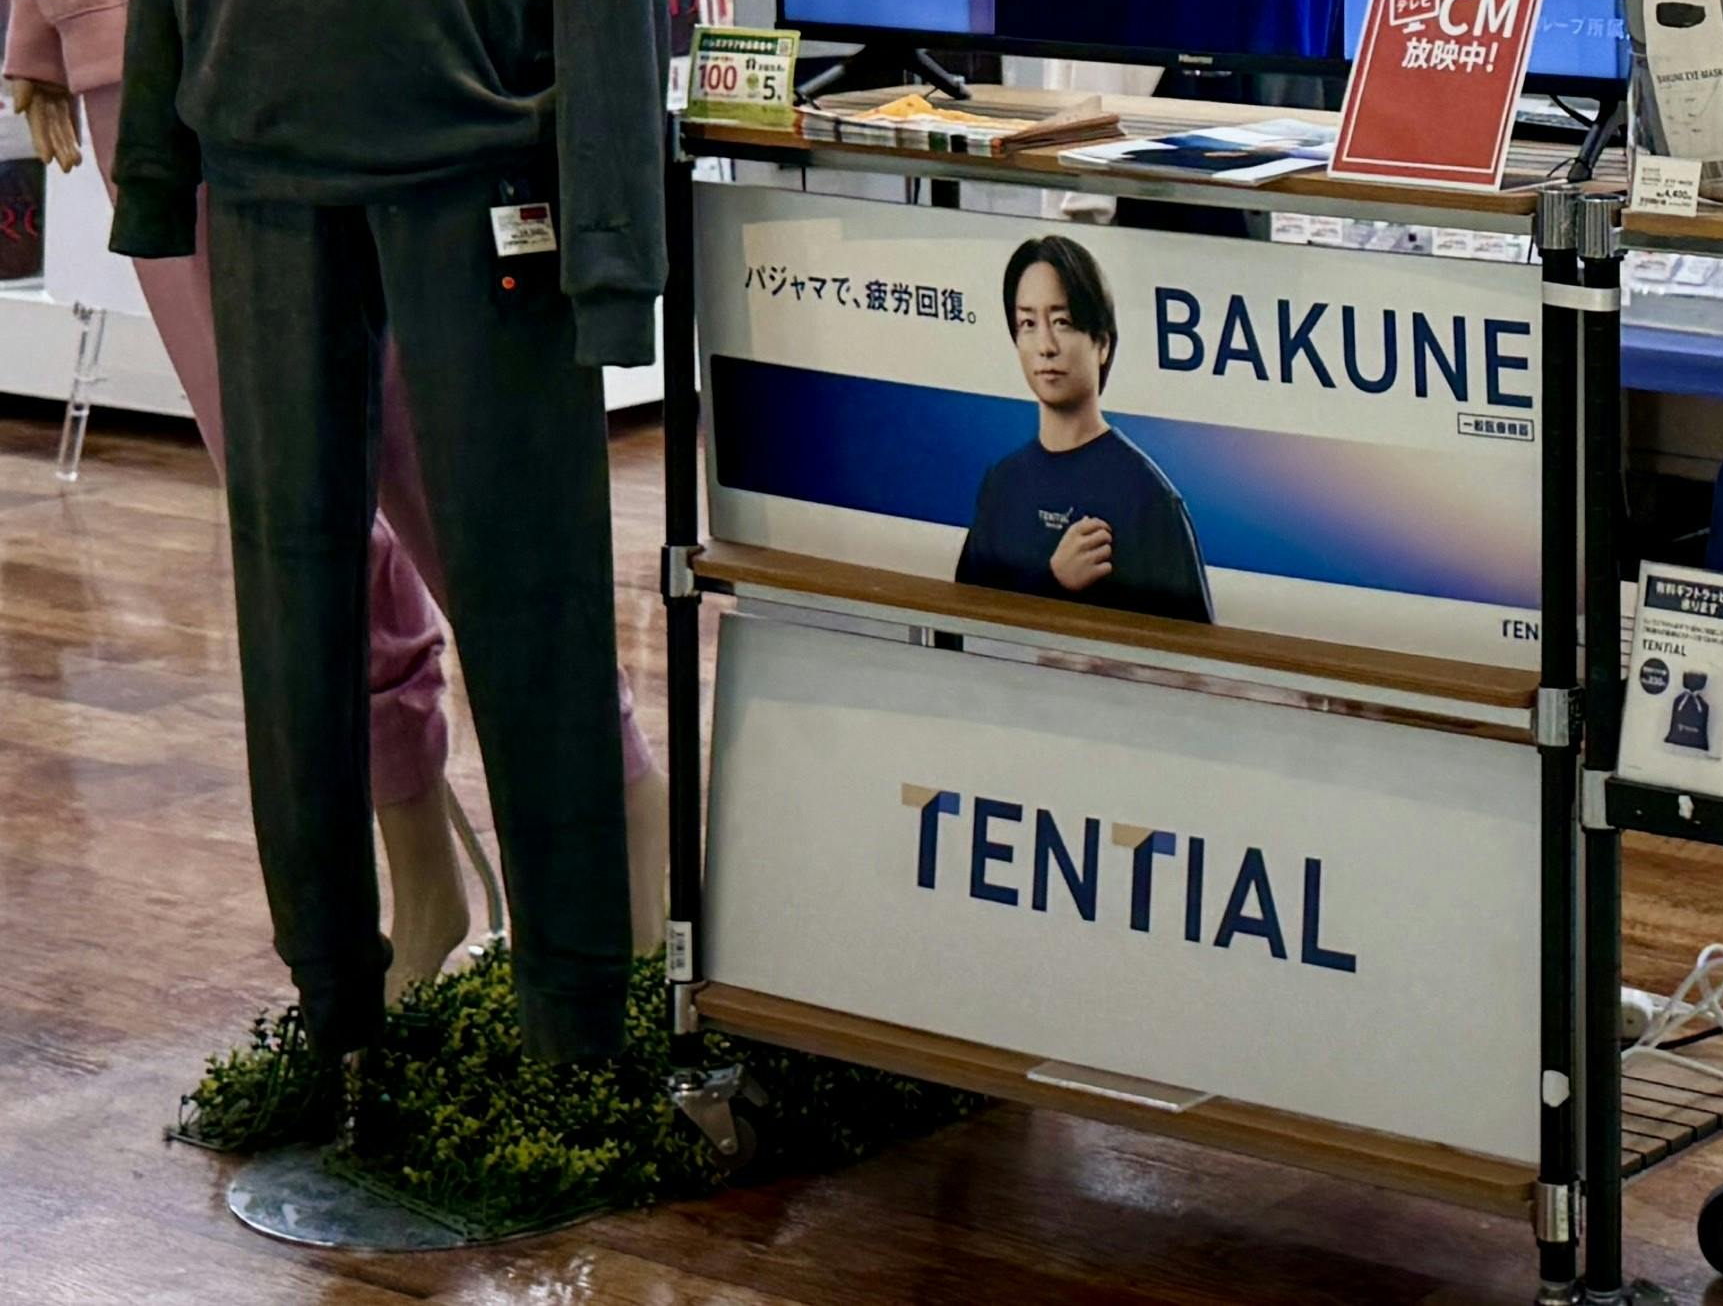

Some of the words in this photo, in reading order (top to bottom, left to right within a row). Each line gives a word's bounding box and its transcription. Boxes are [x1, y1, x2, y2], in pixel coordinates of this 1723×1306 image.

[698, 63, 738, 91] 100
[1401, 36, 1499, 74] 放映中!
[743, 264, 978, 327] パジャマで、疲労回復。
[1154, 286, 1534, 409] BAKUNE
[1642, 638, 1688, 658] TENTIAL
[900, 783, 1358, 974] TENTIAL
